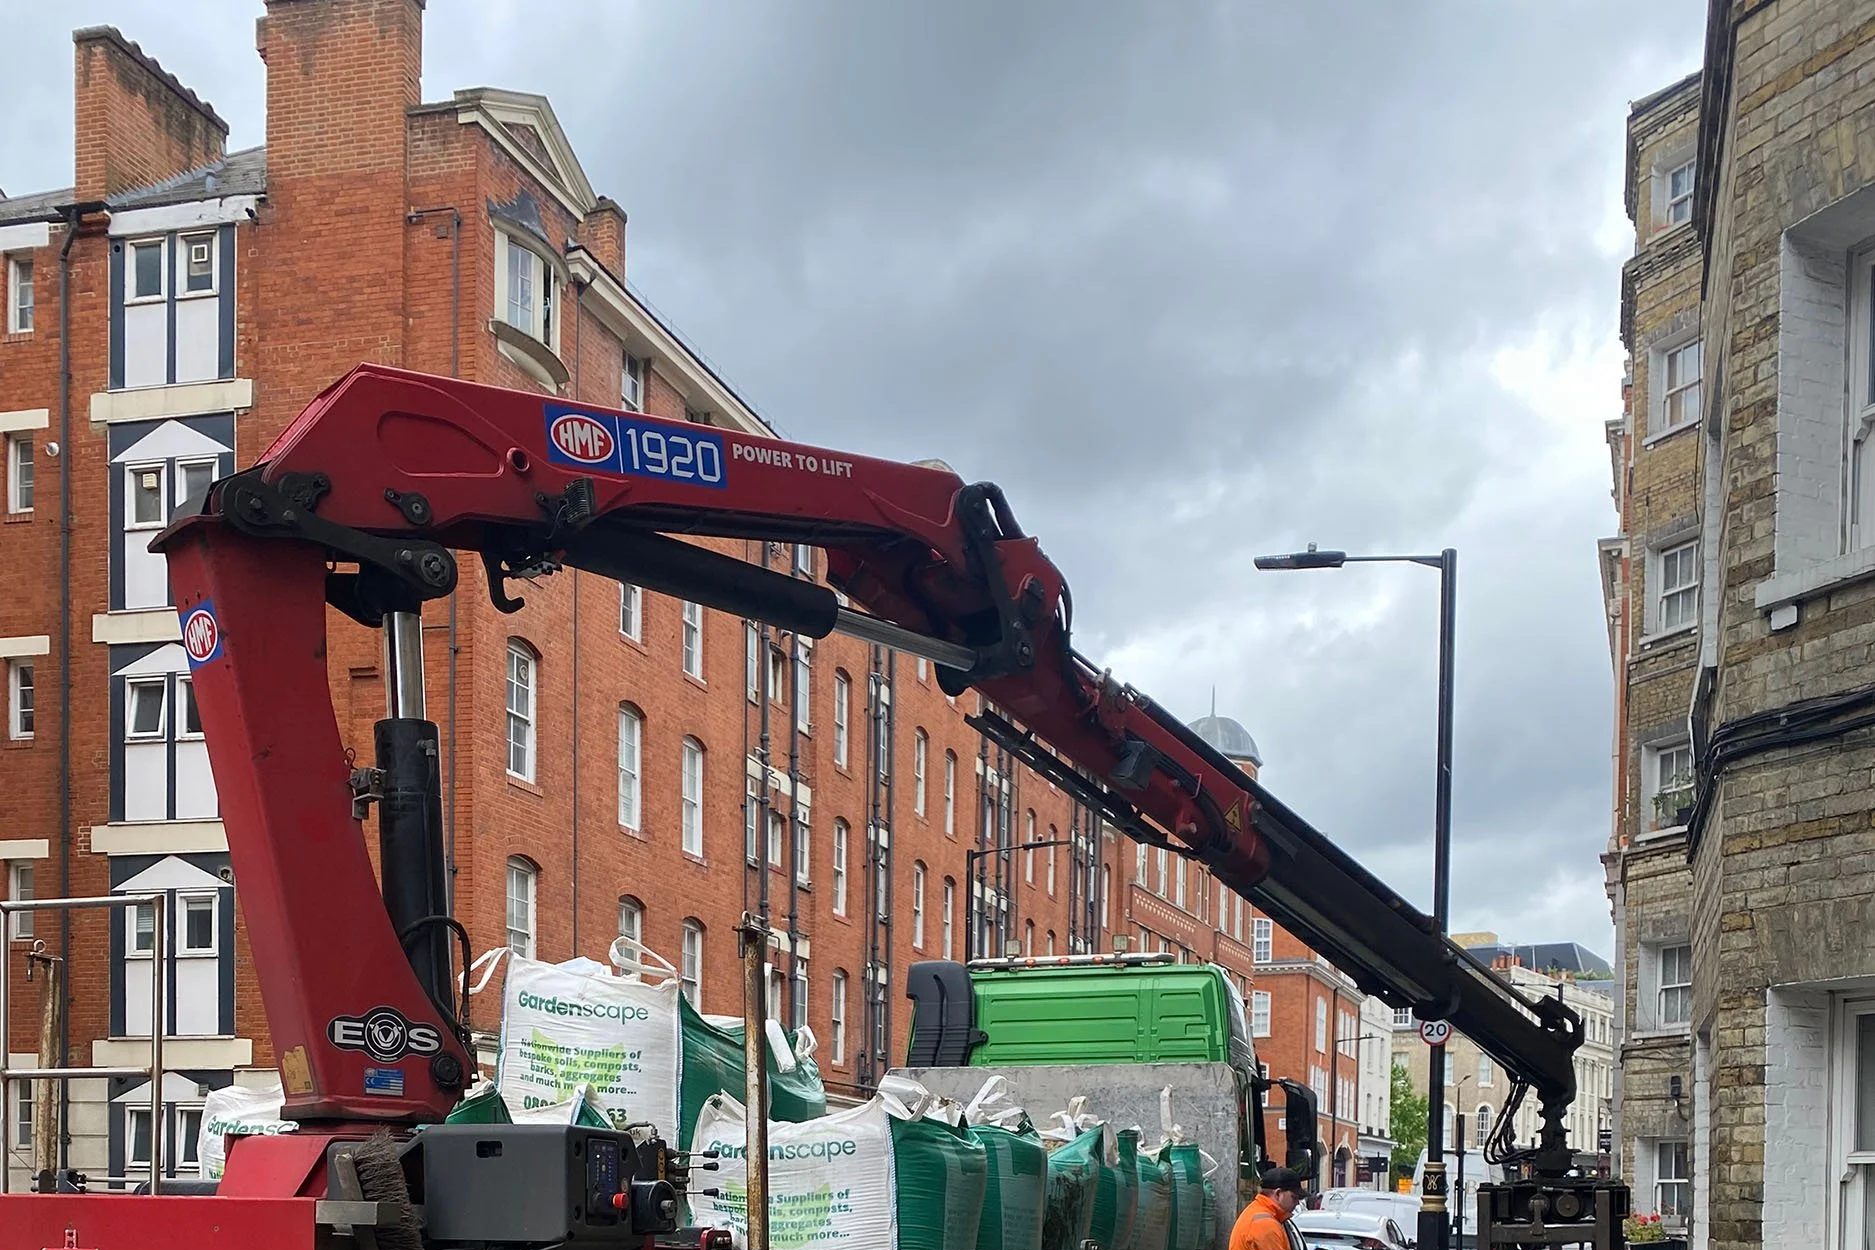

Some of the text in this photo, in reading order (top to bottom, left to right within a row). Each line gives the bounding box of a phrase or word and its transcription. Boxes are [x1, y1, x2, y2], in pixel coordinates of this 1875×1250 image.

[559, 419, 605, 457] HMF
[626, 428, 722, 483] 1920
[732, 443, 853, 478] POWER TO LIFT
[188, 616, 212, 655] HMF
[518, 990, 649, 1025] Gardenscape
[1424, 1023, 1447, 1037] 20
[519, 1048, 642, 1073] bespoke soils, composts,
[574, 1047, 626, 1060] Suppliers
[629, 1050, 642, 1060] of
[530, 1061, 621, 1083] barks, aggregates
[519, 1073, 534, 1082] and
[536, 1076, 561, 1089] much
[597, 1086, 637, 1095] more...
[776, 1191, 834, 1204] Suppliers
[837, 1188, 850, 1199] of
[789, 1204, 853, 1218] composts,
[807, 1229, 850, 1241] more...
